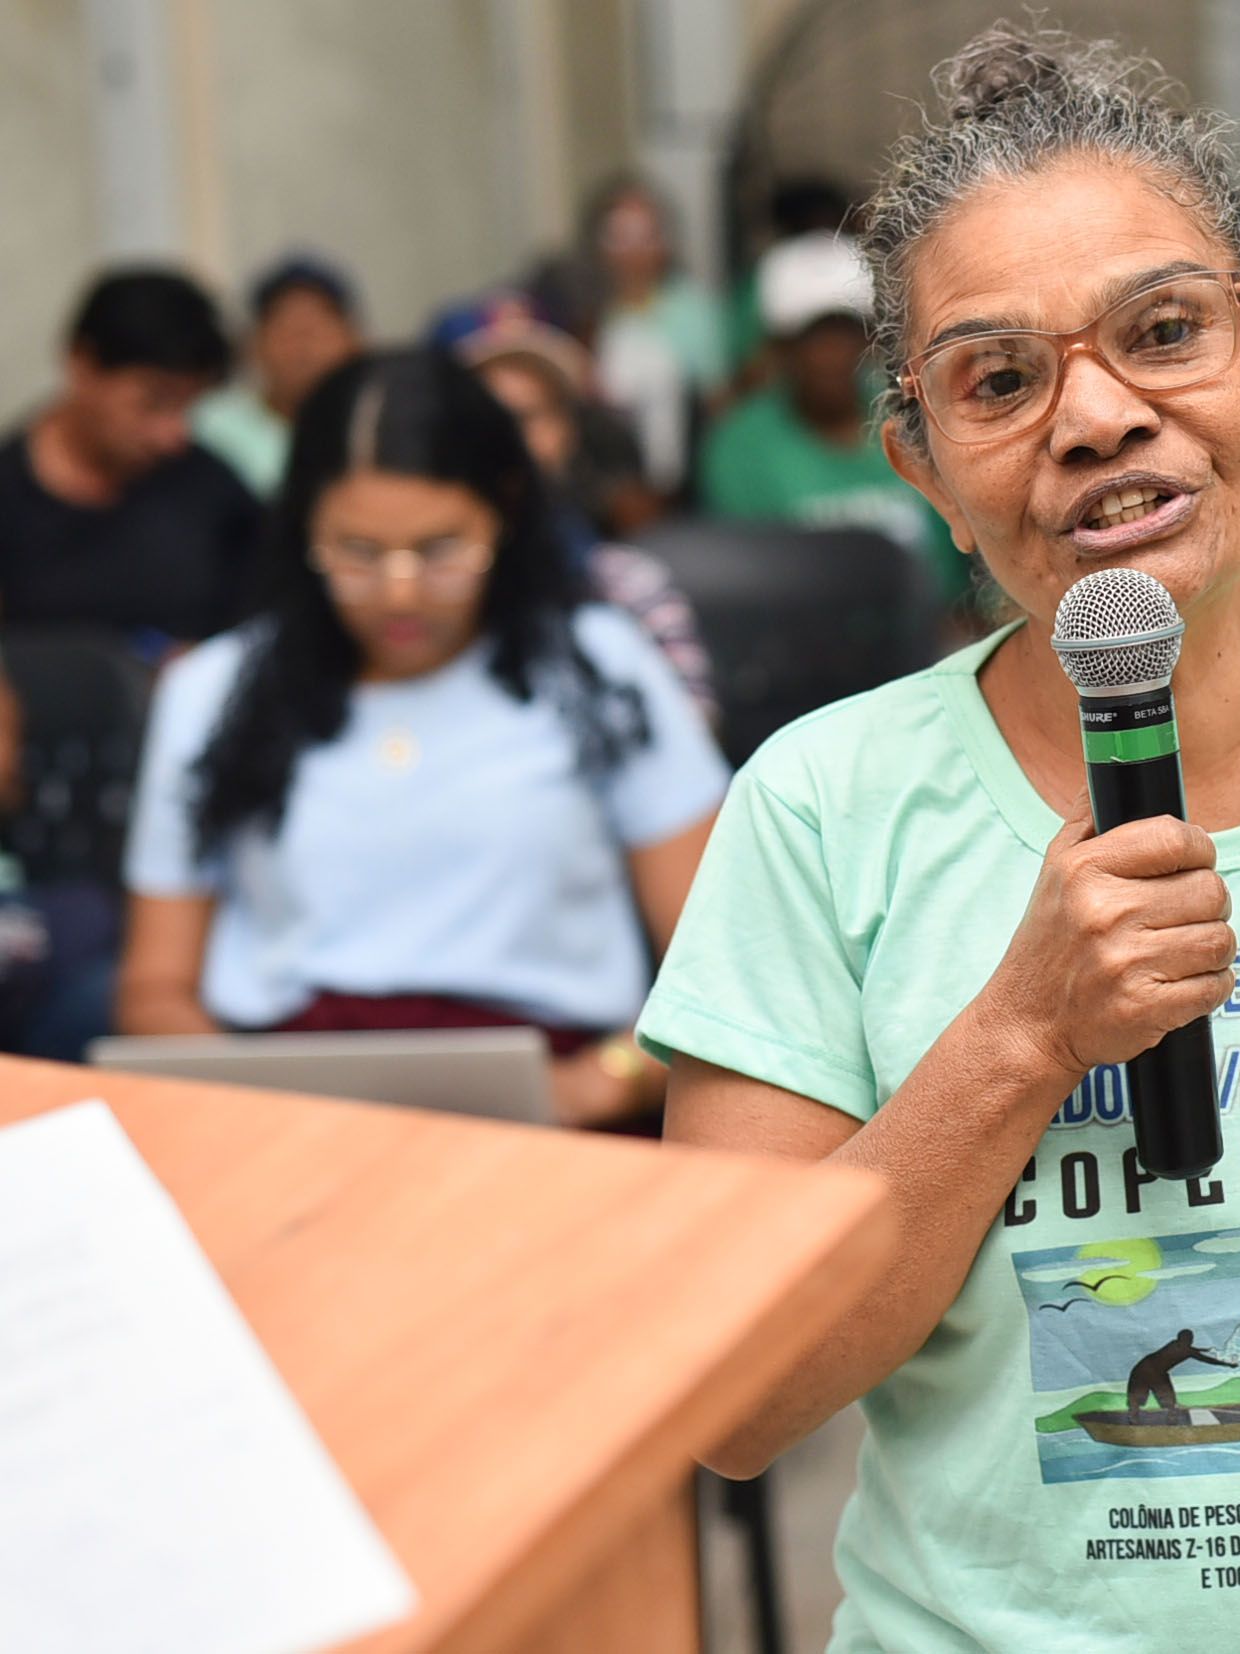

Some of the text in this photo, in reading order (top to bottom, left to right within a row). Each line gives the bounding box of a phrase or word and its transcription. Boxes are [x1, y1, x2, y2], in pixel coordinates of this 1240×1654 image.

[1081, 712, 1113, 722] HURE
[1134, 708, 1157, 720] BETA
[1109, 1504, 1175, 1530] COLÔNIA
[1179, 1507, 1201, 1529] DE
[1086, 1537, 1182, 1561] ARTESANAIS
[1186, 1536, 1226, 1559] Z-16
[1201, 1568, 1212, 1589] E
